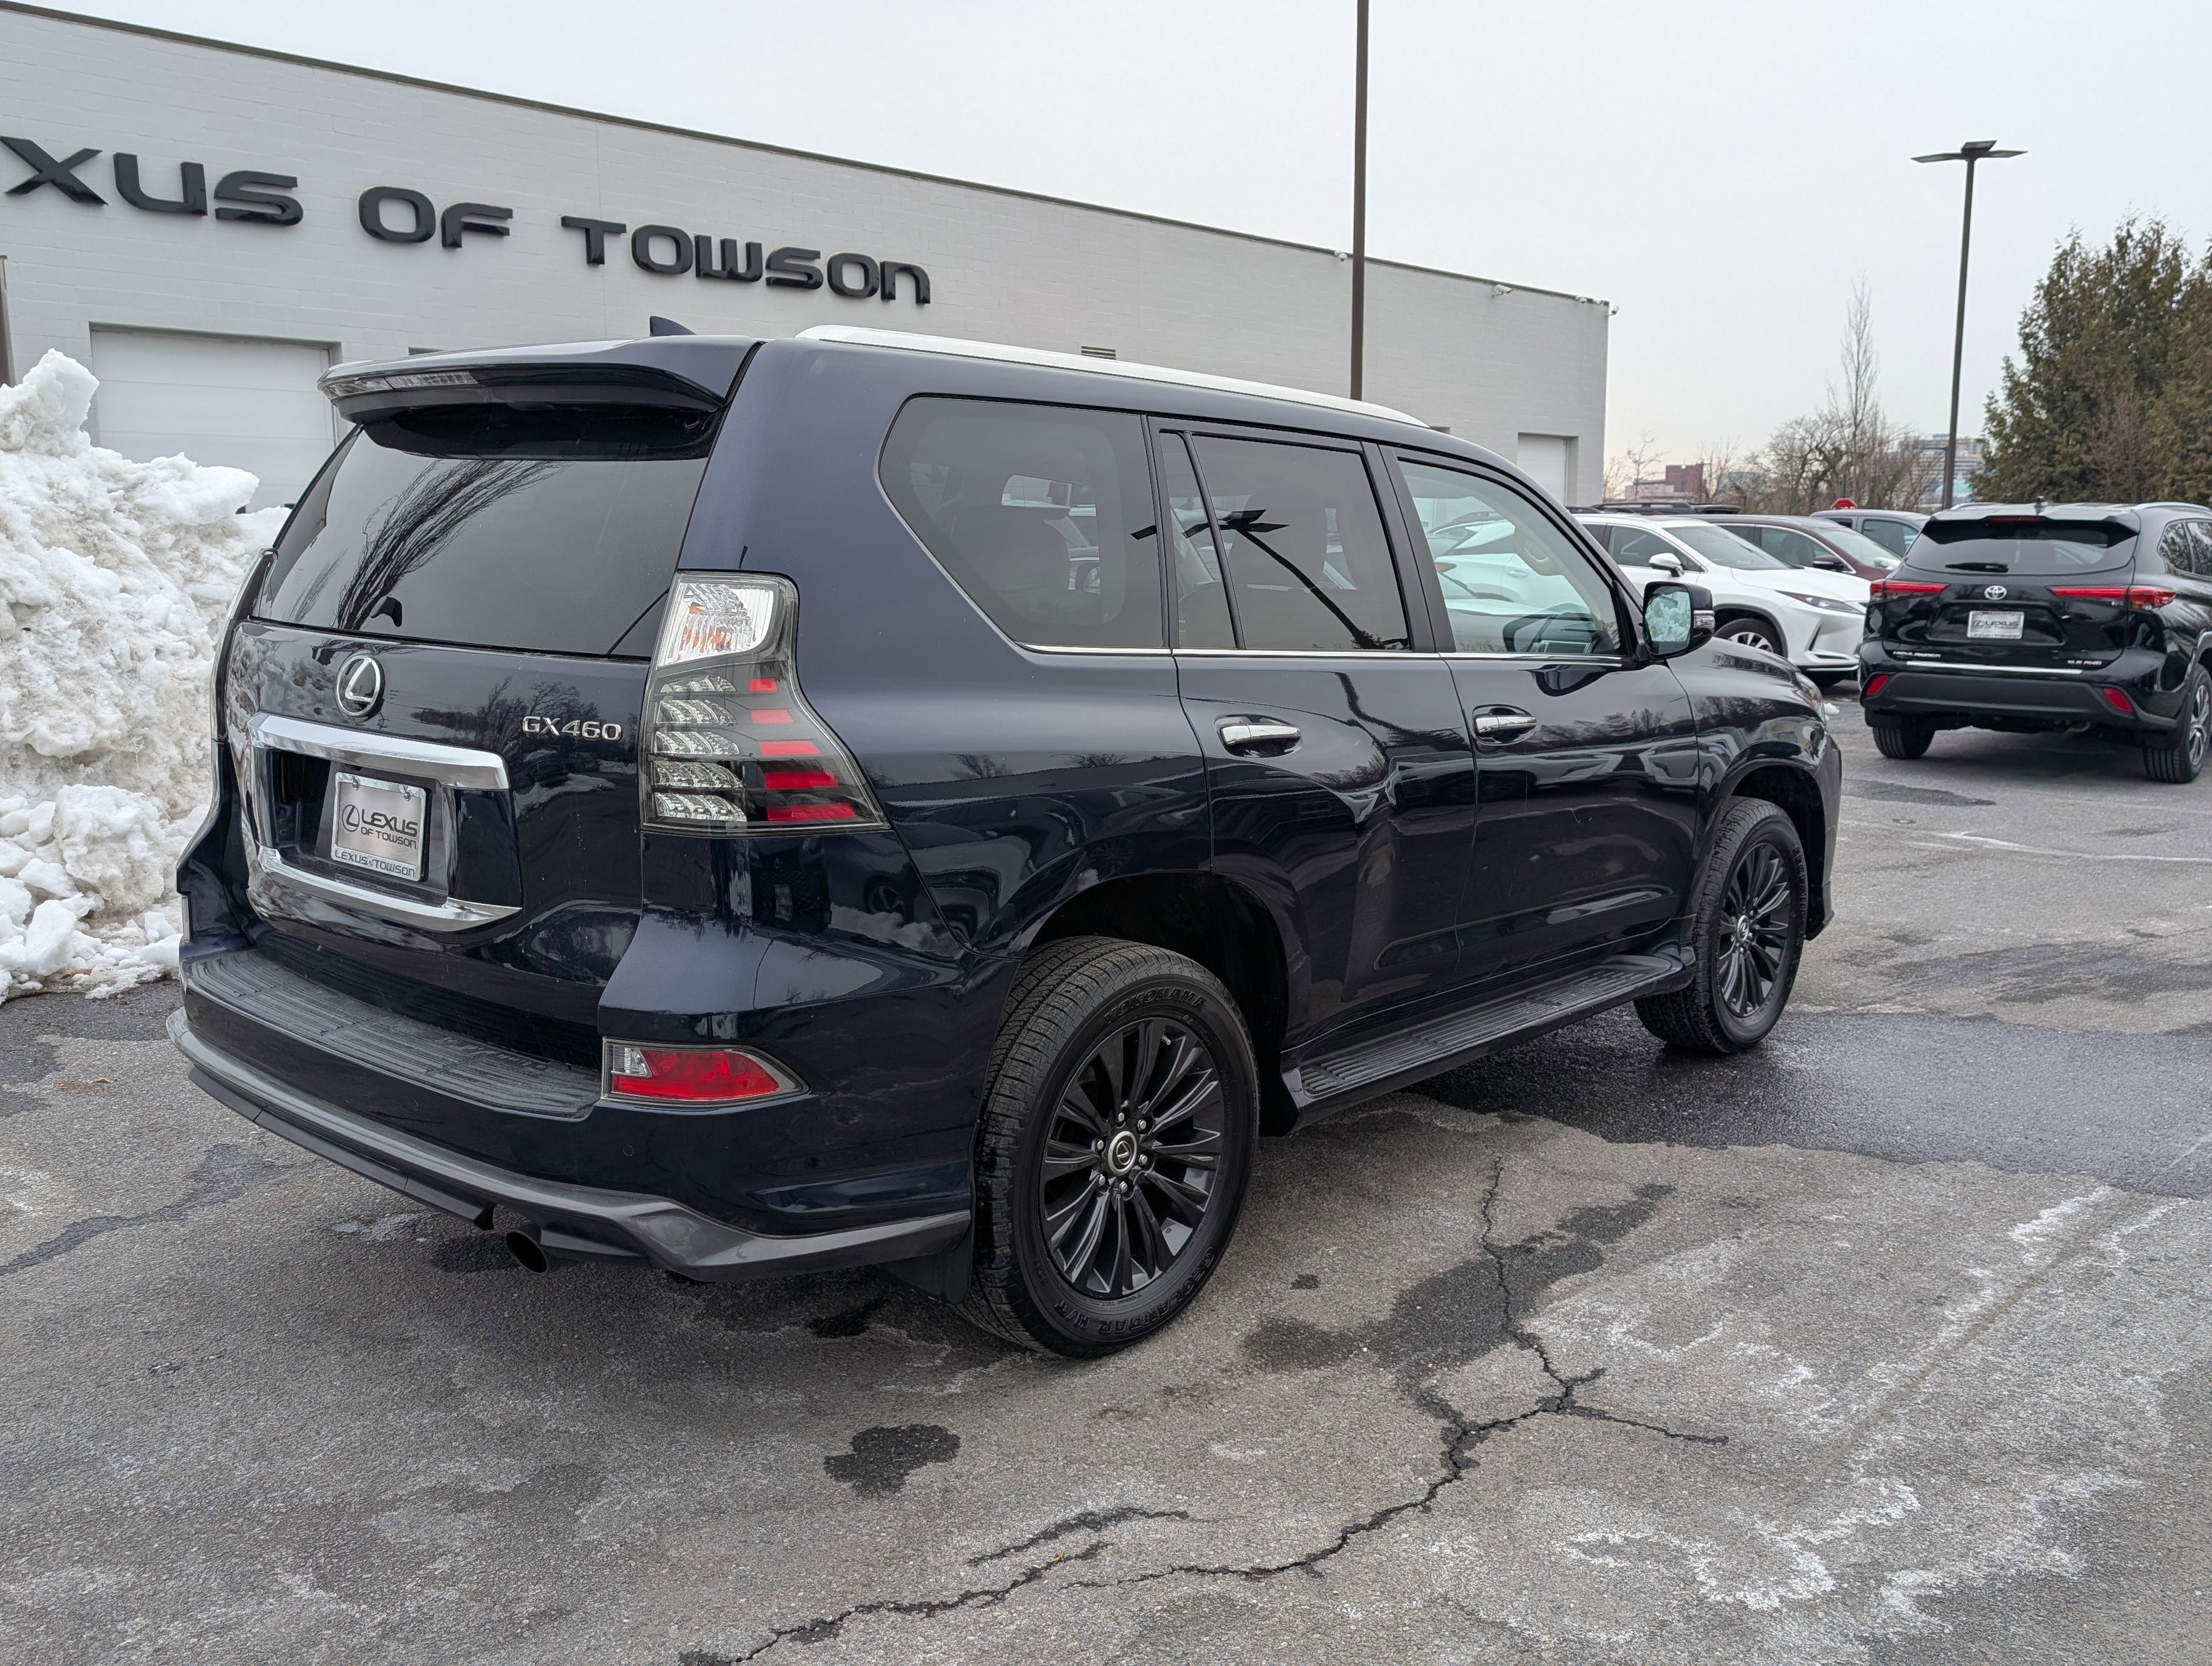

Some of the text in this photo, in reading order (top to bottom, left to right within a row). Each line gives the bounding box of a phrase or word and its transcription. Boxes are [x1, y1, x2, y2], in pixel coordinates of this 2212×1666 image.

[358, 185, 513, 248] OF
[561, 215, 931, 304] TOWSON
[522, 716, 623, 741] GX460
[362, 808, 418, 837] LEXUS
[361, 826, 416, 849] OF TOWSON
[335, 849, 368, 866] LEXUS
[373, 860, 415, 877] TOWSON
[1103, 987, 1207, 1024] YOKOHAMA
[1098, 1246, 1215, 1335] GEOLANDAR
